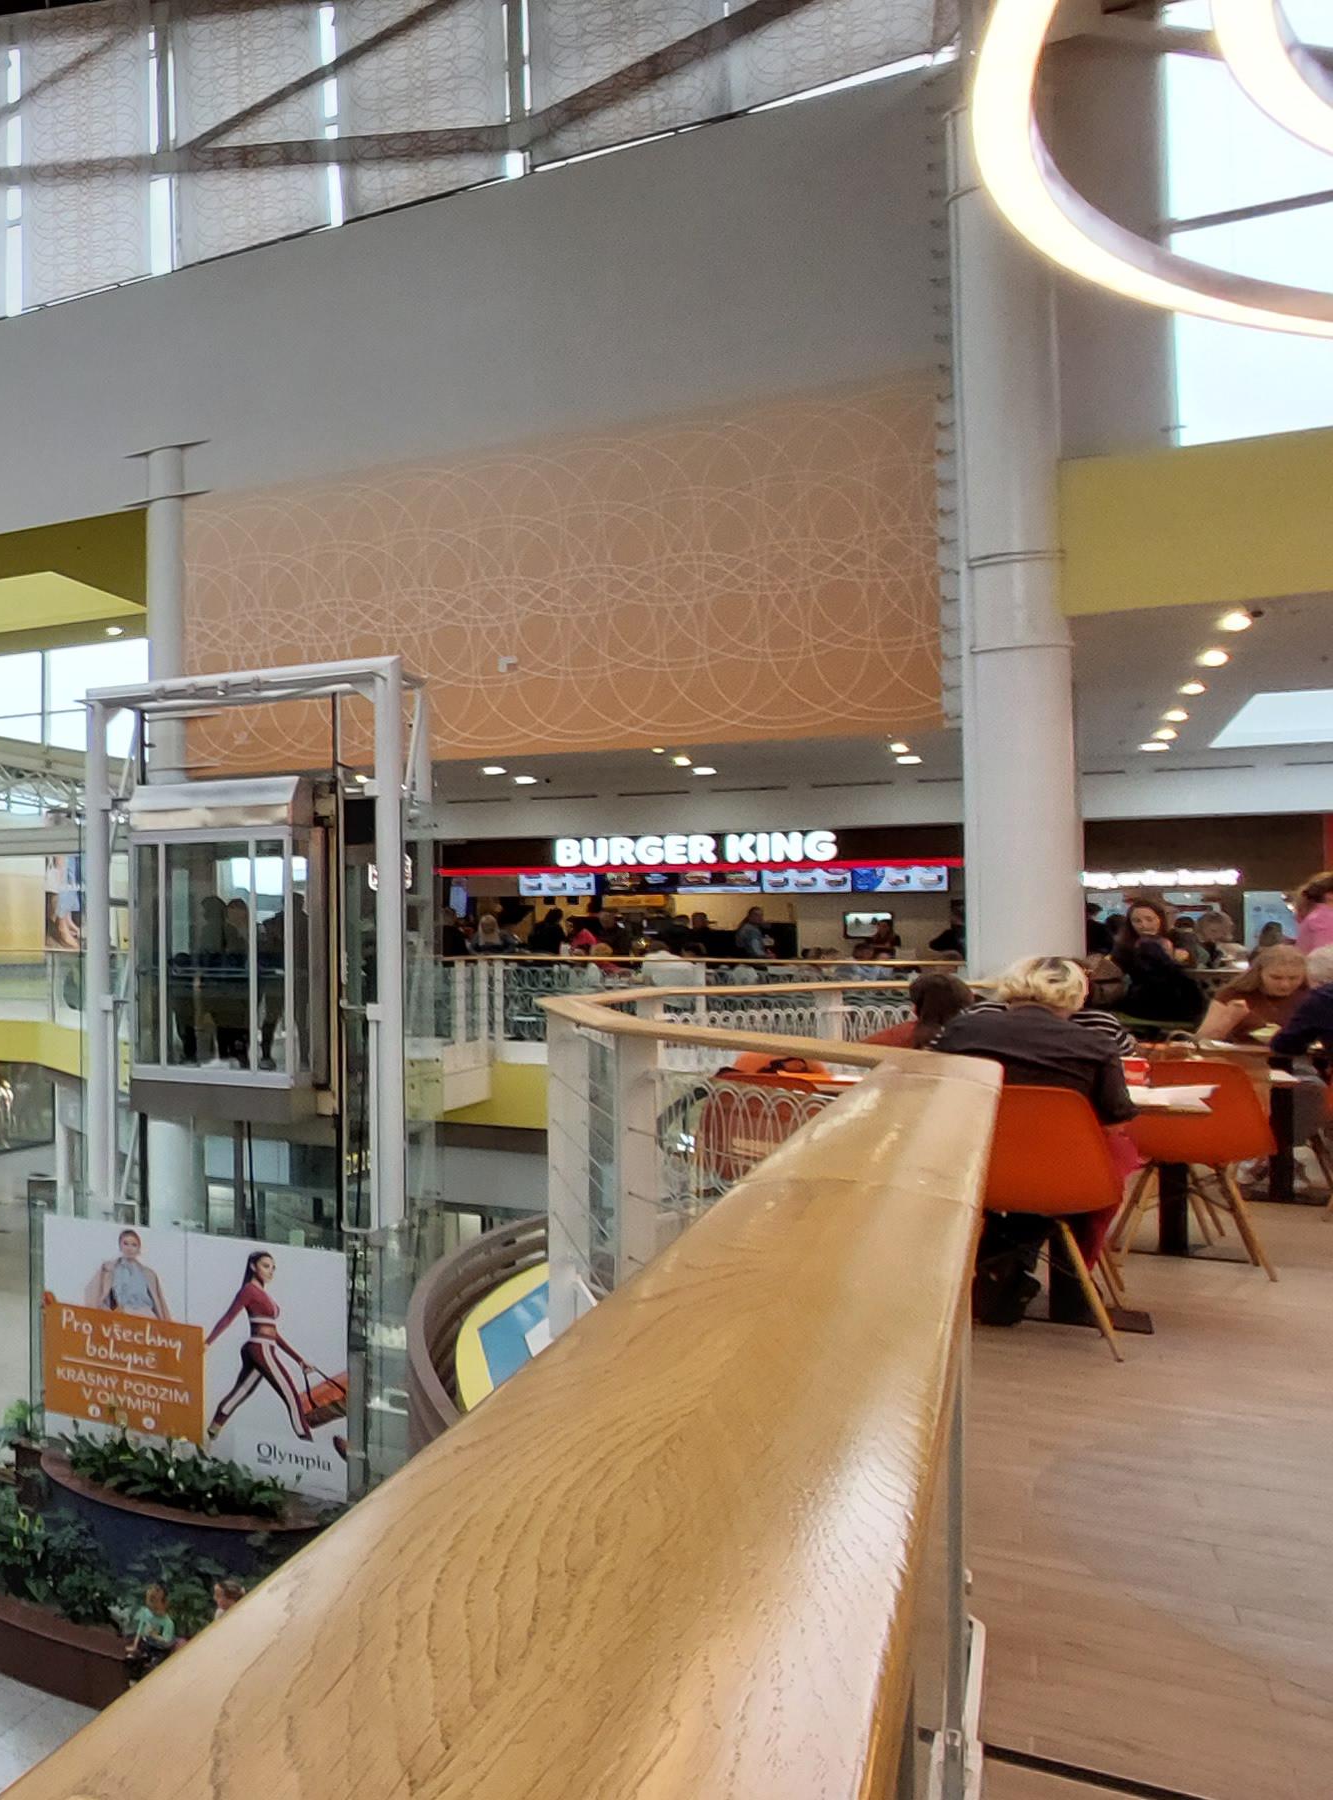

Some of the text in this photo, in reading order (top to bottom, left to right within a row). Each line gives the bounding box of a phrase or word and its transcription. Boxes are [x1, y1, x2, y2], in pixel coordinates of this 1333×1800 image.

[555, 830, 838, 868] BURGER KING
[61, 1308, 182, 1361] Pro všechny
[86, 1336, 158, 1373] bohyně
[82, 1387, 92, 1400] V
[123, 1379, 190, 1404] PODZIM
[257, 1442, 331, 1472] Olympia
